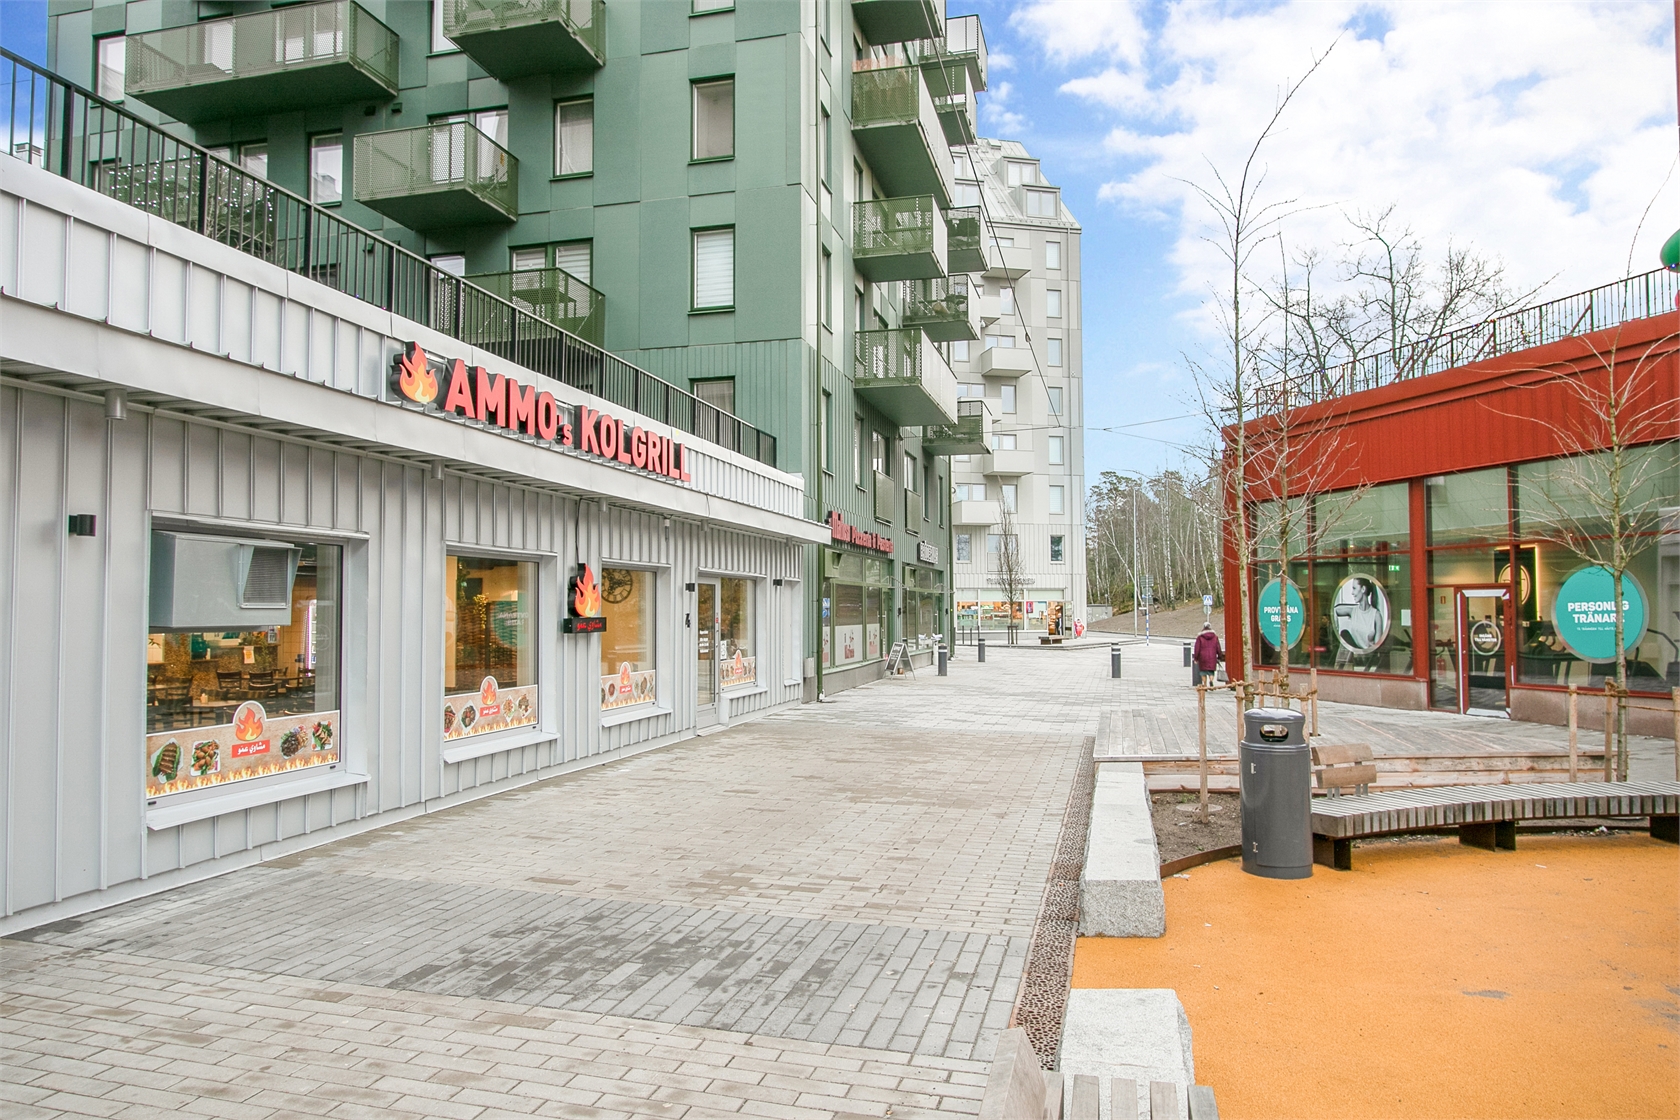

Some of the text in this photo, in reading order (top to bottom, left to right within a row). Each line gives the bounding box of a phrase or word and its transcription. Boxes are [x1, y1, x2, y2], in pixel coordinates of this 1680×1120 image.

[579, 404, 691, 483] KOLGRILL
[1263, 604, 1299, 614] PROVTÄNA
[1567, 600, 1629, 612] PERSONLG
[1270, 614, 1292, 622] GRAS
